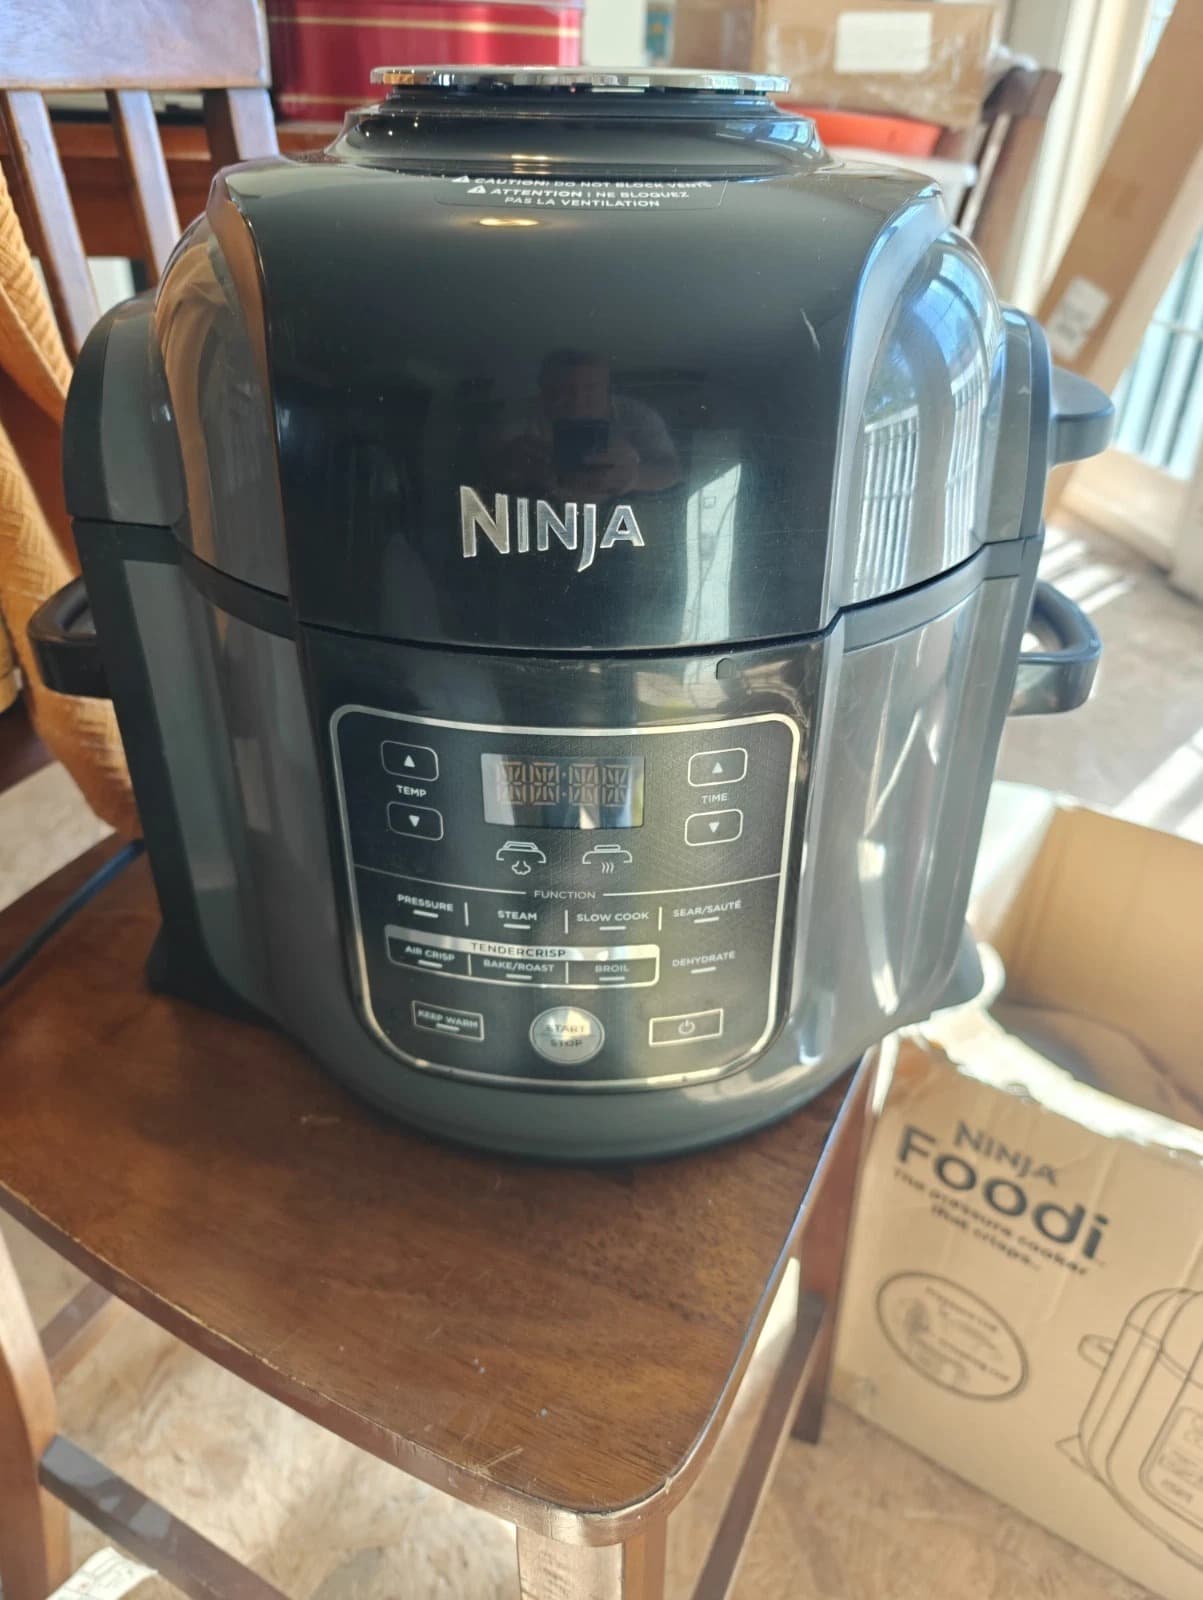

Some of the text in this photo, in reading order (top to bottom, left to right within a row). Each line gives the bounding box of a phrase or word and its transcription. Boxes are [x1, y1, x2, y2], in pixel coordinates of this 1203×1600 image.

[490, 188, 582, 197] ATTENTION
[505, 196, 532, 204] PAS
[561, 199, 660, 207] VENTILATION
[460, 485, 646, 573] NINJA
[396, 784, 427, 798] TEMP
[701, 793, 728, 804] TIME
[533, 889, 597, 901] FUNCTION
[396, 893, 454, 913] PRESSURE
[497, 910, 538, 921] STEAM
[576, 911, 650, 923] SLOW COOK
[404, 945, 456, 961] AIR CRISP
[471, 942, 567, 958] TENDERCRISP
[483, 958, 555, 973] BAKE/ROAST
[672, 950, 736, 968] DEHYDRATE
[595, 964, 630, 974] BROIL
[418, 1009, 479, 1029] KEEP WARM
[550, 1039, 582, 1048] STOP
[954, 1120, 1058, 1189] NINJA
